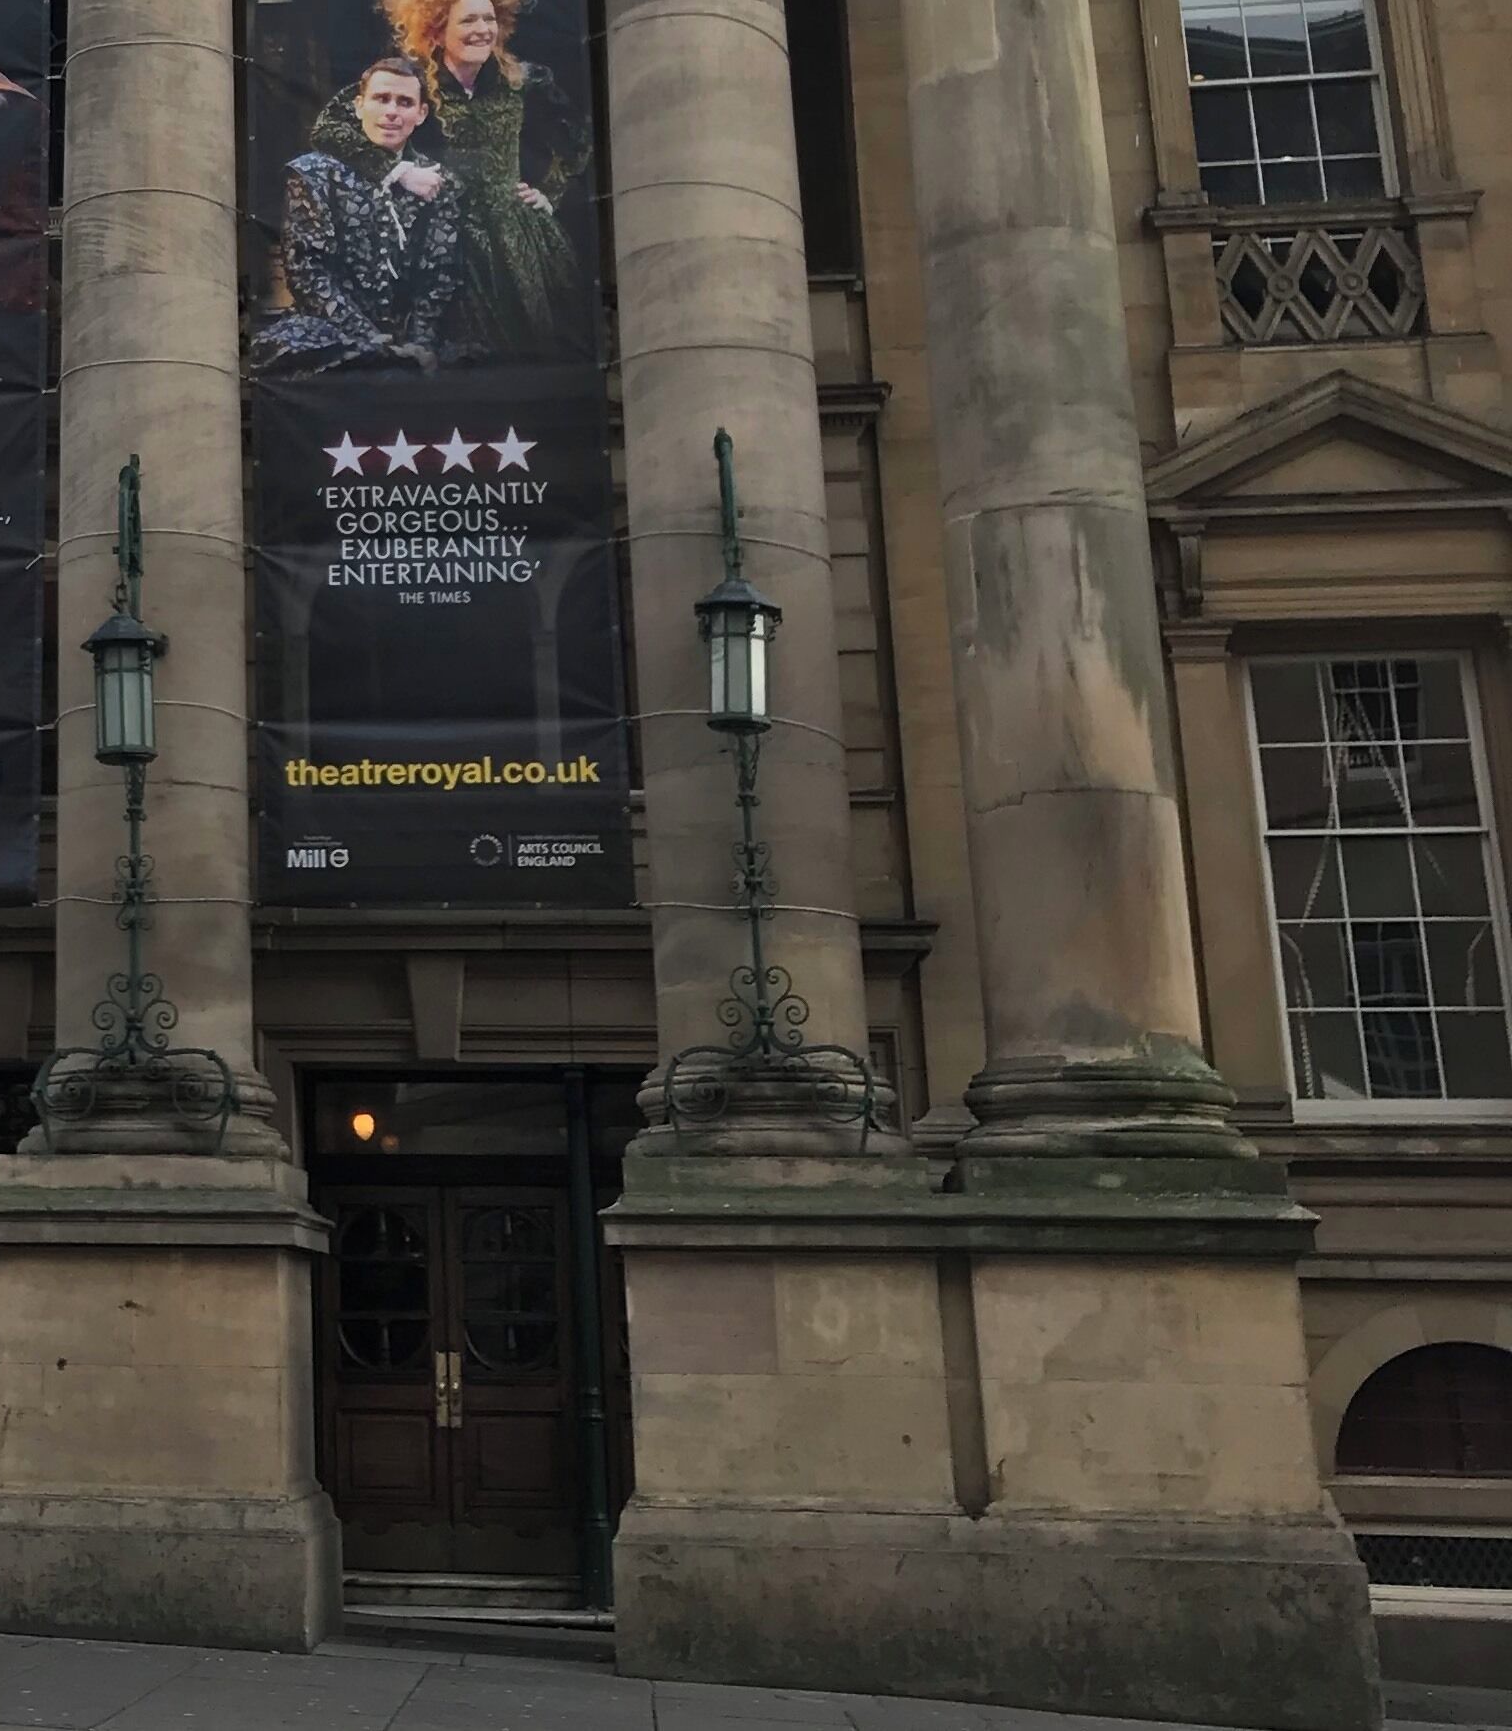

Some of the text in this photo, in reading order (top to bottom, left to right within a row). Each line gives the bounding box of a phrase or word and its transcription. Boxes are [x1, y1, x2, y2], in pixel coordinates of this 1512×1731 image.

[341, 535, 527, 561] EXUBERANTLY
[399, 590, 472, 605] THE TIMES
[285, 755, 600, 791] theatreroyal.co.uk
[517, 843, 605, 854] ARTS COUNCIL
[287, 849, 326, 868] Mill
[517, 855, 577, 867] ENGLAND
